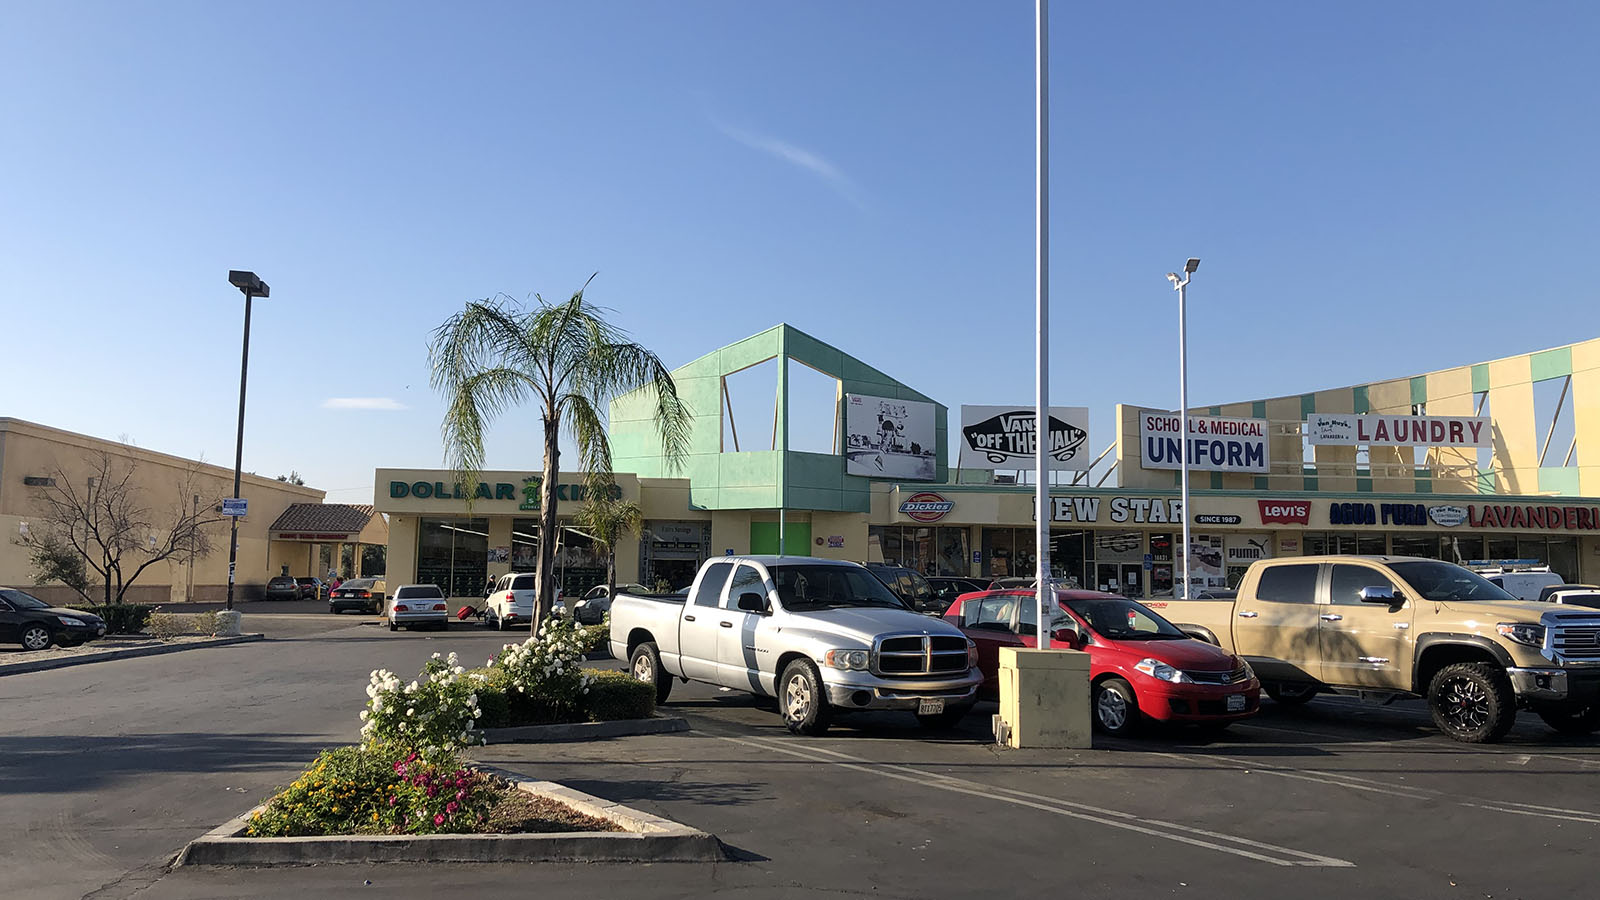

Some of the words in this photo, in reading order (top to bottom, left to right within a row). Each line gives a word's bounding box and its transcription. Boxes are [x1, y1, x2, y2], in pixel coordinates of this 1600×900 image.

[1000, 416, 1036, 432] VANS
[1147, 416, 1196, 434] SCHOL
[1198, 420, 1208, 434] &
[1211, 421, 1263, 437] MEDICAL
[1357, 419, 1483, 443] LAUNDRY
[1005, 432, 1036, 453] THE
[1148, 437, 1264, 467] UNIFORM
[390, 481, 515, 500] DOLLAR
[1110, 497, 1185, 523] STAR
[1329, 503, 1376, 524] AGUA
[1380, 503, 1428, 525] PURA
[1229, 548, 1259, 558] PUMA
